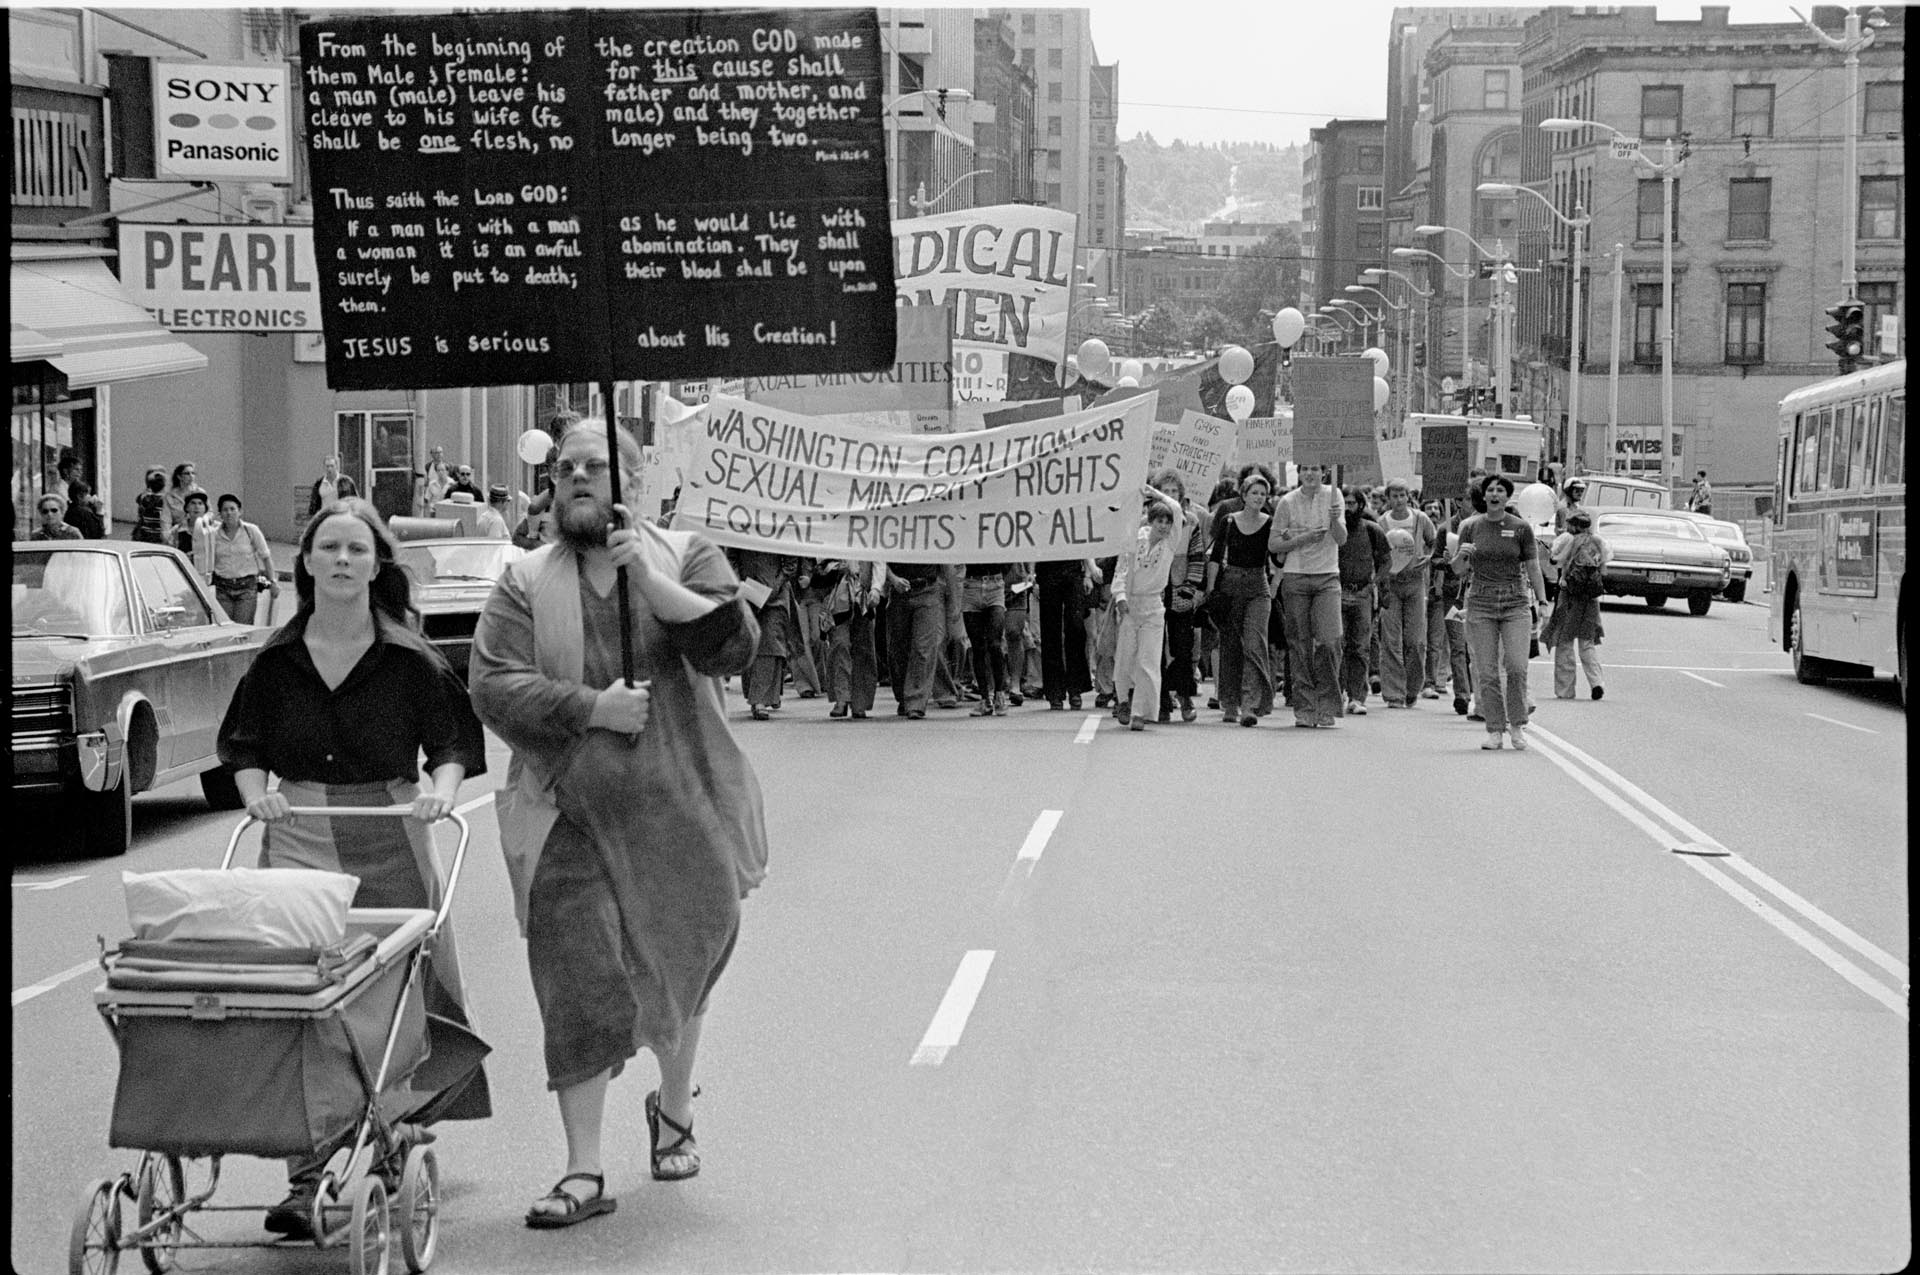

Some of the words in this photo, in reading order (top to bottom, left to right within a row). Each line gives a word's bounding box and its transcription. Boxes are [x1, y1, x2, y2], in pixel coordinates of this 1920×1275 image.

[318, 33, 365, 57] From
[382, 34, 416, 56] the
[432, 33, 531, 64] beginning
[545, 36, 564, 56] of
[595, 37, 633, 57] the
[644, 35, 739, 56] creation
[752, 26, 799, 52] GOD
[813, 31, 862, 50] made
[307, 66, 357, 84] them
[368, 64, 414, 84] Male
[445, 60, 530, 83] Female:
[606, 60, 640, 80] for
[652, 59, 698, 82] this
[713, 59, 773, 77] cause
[788, 52, 845, 76] shall
[167, 78, 279, 103] SONY
[310, 92, 321, 105] a
[334, 91, 376, 106] man
[390, 85, 456, 107] (male)
[469, 82, 524, 102] leave
[538, 83, 565, 102] his
[604, 83, 672, 101] father
[689, 83, 720, 101] and
[736, 81, 817, 102] mother,
[828, 81, 866, 100] and
[312, 109, 371, 126] cleave
[385, 109, 406, 126] to
[424, 108, 453, 125] his
[474, 107, 519, 125] wife
[606, 102, 663, 125] male)
[674, 103, 709, 121] and
[718, 102, 758, 131] they
[771, 102, 860, 128] together
[168, 140, 278, 161] Panasonic
[314, 130, 360, 149] shall
[379, 131, 400, 150] be
[418, 135, 460, 153] one
[471, 129, 538, 153] flesh,
[550, 136, 573, 149] no
[612, 128, 675, 155] longer
[696, 124, 754, 155] being
[768, 124, 818, 146] two.
[1613, 141, 1639, 150] POWER
[1617, 150, 1632, 159] OFF
[330, 188, 374, 209] Thus
[387, 192, 425, 208] saith
[433, 191, 458, 206] the
[521, 185, 567, 203] GOD:
[368, 226, 379, 236] a
[391, 224, 424, 237] man
[437, 218, 460, 235] lie
[478, 218, 513, 235] with
[528, 222, 539, 233] a
[548, 220, 580, 233] man
[621, 217, 641, 231] as
[655, 213, 676, 231] he
[695, 213, 749, 232] would
[769, 212, 795, 229] lie
[822, 208, 865, 227] with
[145, 231, 310, 291] PEARL
[337, 248, 346, 259] a
[358, 247, 416, 259] woman
[440, 241, 453, 258] it
[473, 240, 489, 257] is
[505, 245, 525, 256] an
[536, 239, 581, 257] awful
[622, 236, 743, 254] abomination.
[755, 234, 799, 262] They
[818, 231, 859, 249] shall
[892, 223, 1068, 287] DICAL
[339, 269, 391, 294] surely
[411, 266, 429, 283] be
[453, 269, 484, 291] put
[491, 267, 509, 283] to
[525, 266, 577, 288] death;
[625, 262, 666, 278] their
[681, 260, 721, 278] blood
[737, 259, 772, 276] shall
[787, 258, 807, 276] be
[829, 260, 865, 278] upon
[339, 298, 385, 312] them.
[897, 287, 1036, 348] MEN
[344, 337, 411, 358] JESUS
[435, 336, 448, 353] is
[469, 331, 549, 351] serious
[638, 327, 685, 347] about
[754, 321, 836, 345] Creation!
[1194, 418, 1220, 436] GAYS
[707, 408, 902, 478] WASHINGTON
[705, 448, 824, 509] SEXUAL
[1014, 452, 1121, 497] RIGHTS
[1176, 459, 1209, 477] UNITE
[705, 497, 827, 543] EQUAL
[848, 513, 955, 550] RIGHTS
[978, 510, 1045, 549] FOR
[1049, 505, 1104, 545] ALL
